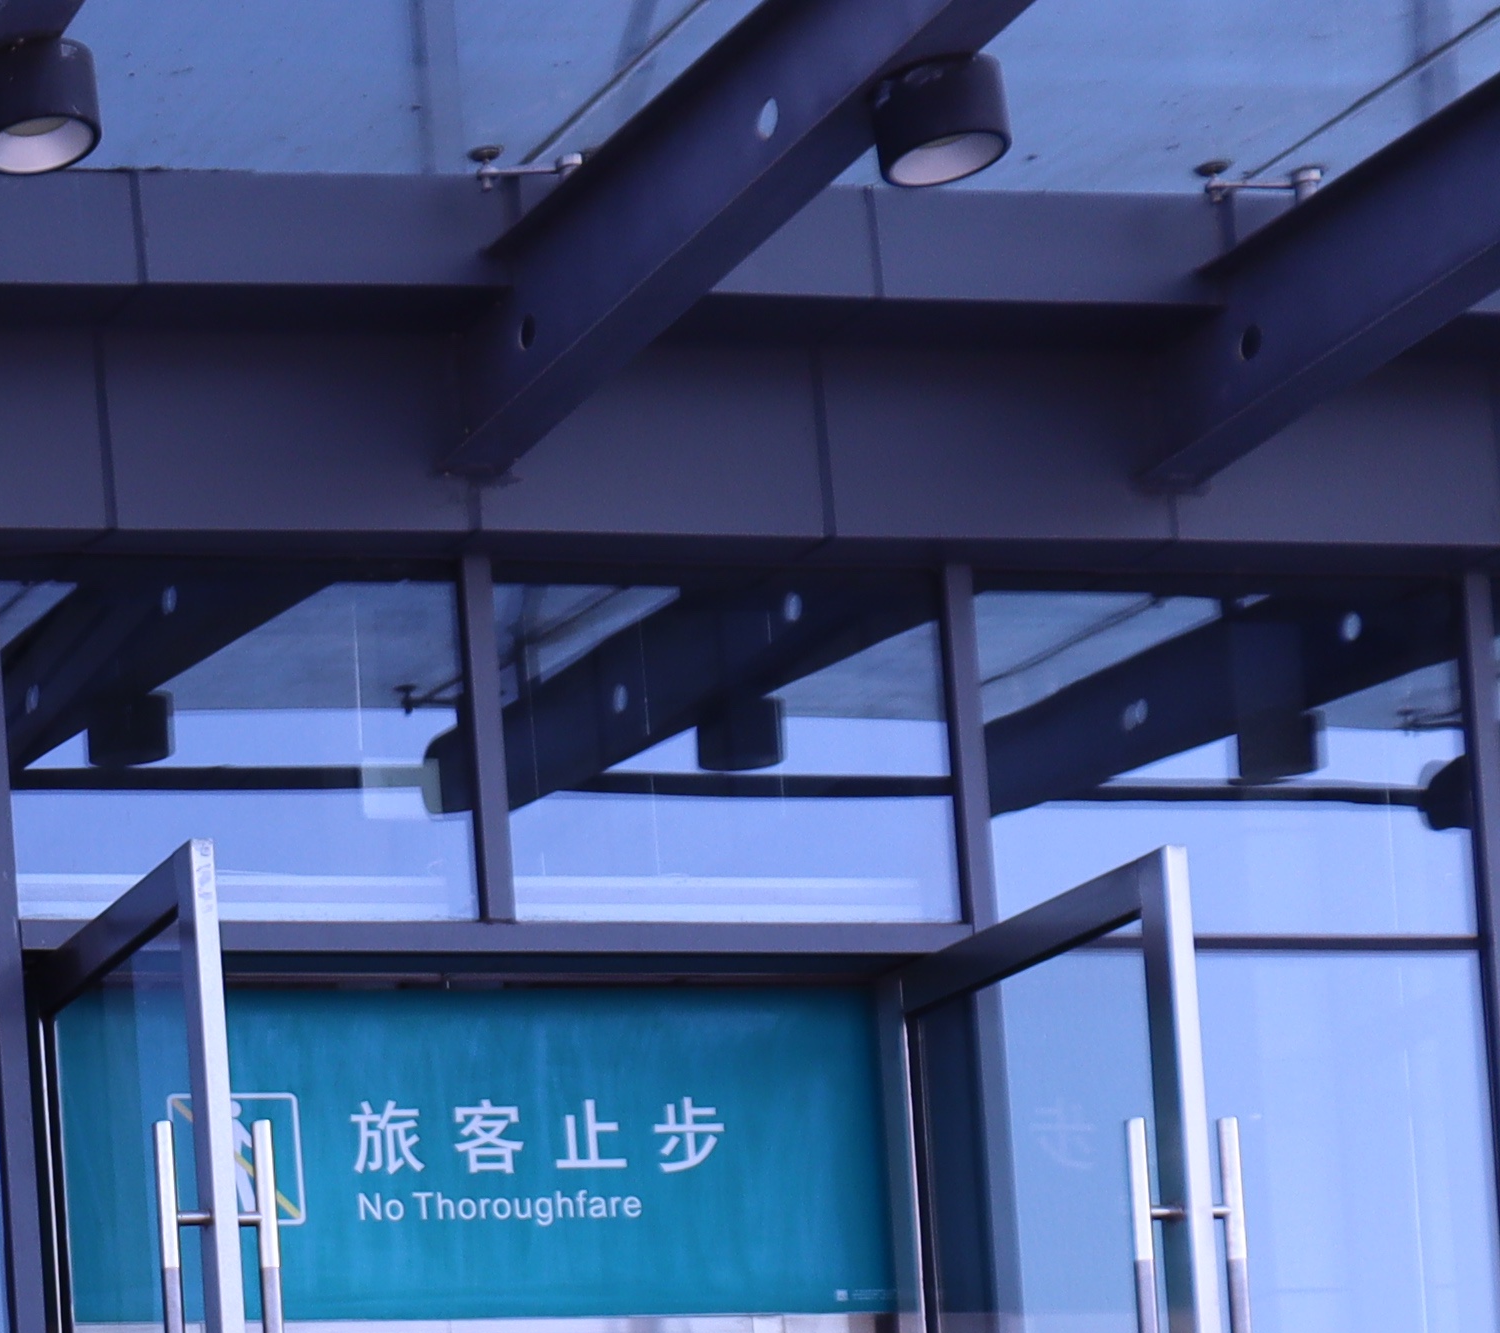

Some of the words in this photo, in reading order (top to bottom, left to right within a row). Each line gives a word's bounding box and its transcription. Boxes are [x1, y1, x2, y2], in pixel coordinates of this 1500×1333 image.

[349, 1095, 726, 1175] 旅客止步
[357, 1191, 404, 1222] No
[411, 1189, 643, 1228] Thoroughfare
